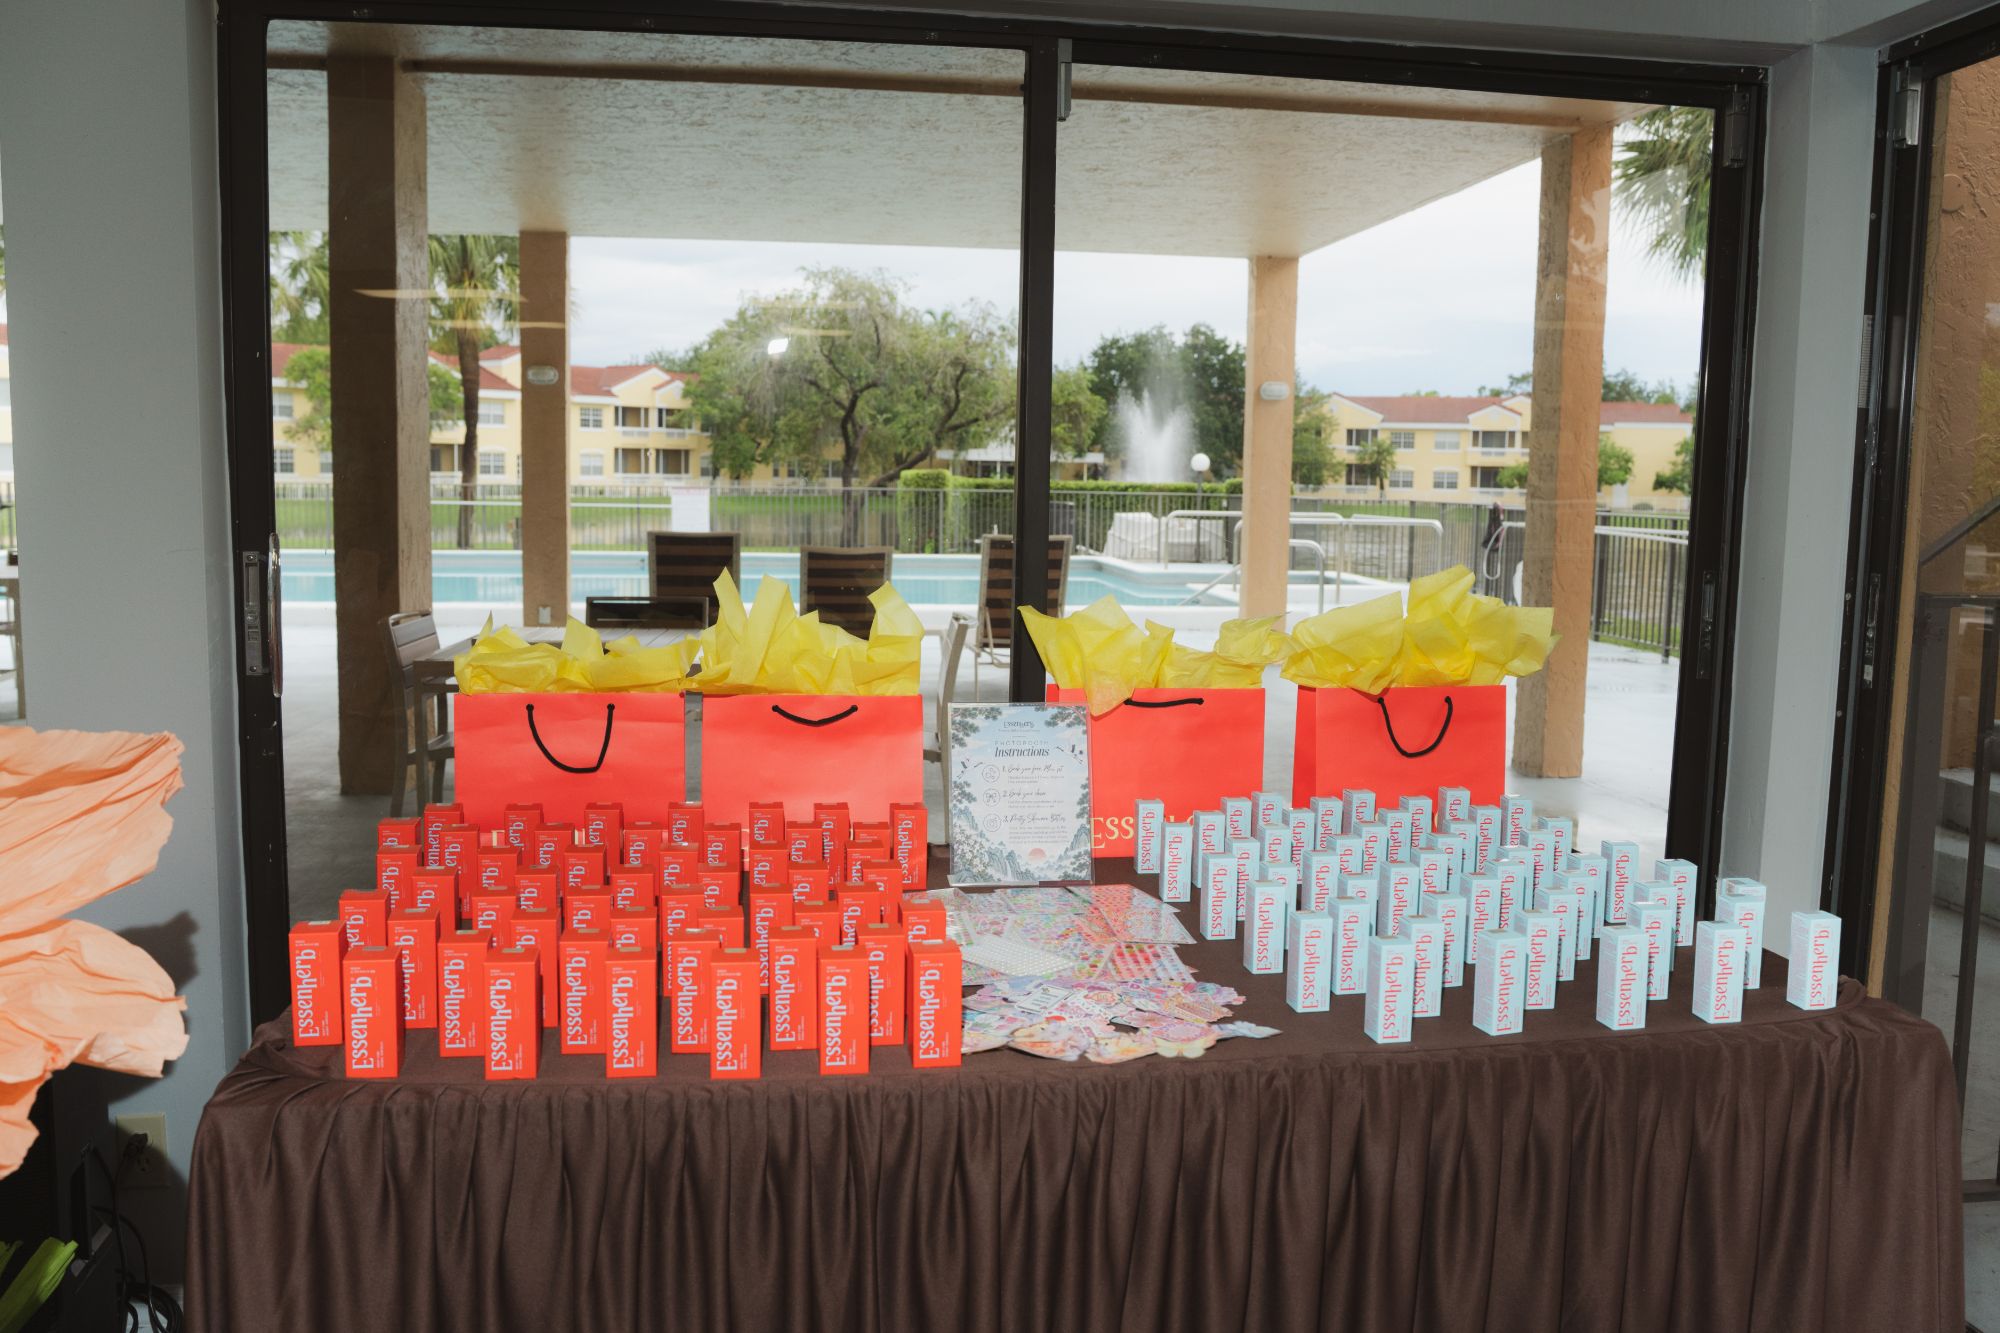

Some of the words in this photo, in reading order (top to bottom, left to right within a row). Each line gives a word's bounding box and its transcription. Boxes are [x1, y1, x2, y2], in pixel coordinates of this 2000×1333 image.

[994, 746, 1050, 758] Instructions
[1141, 811, 1156, 871] Essenherb
[1167, 835, 1182, 900] Essenherb
[1510, 807, 1524, 846] enherb
[1211, 868, 1228, 937] Essenherb
[1315, 865, 1330, 911] enherb
[1613, 854, 1630, 920] Essenherb
[1257, 897, 1275, 971] Essenherb
[1302, 930, 1321, 1009] Essenherb
[1340, 915, 1359, 991] Essenherb
[1413, 935, 1433, 1014] Essenherb
[1528, 928, 1548, 1007] Essenherb
[1810, 929, 1830, 1008] Essenherb
[296, 949, 320, 1039] Essenherb
[444, 959, 466, 1049] Essenherb
[566, 956, 588, 1046] Essenherb
[678, 956, 698, 1045] Essenherb
[774, 954, 795, 1042] Essenherb
[826, 975, 847, 1067] Essenherb
[919, 968, 941, 1060] Essenherb
[1382, 956, 1403, 1040] Essenherb
[1496, 950, 1516, 1032] Essenherb
[1618, 945, 1639, 1027] Essenherb
[1714, 939, 1735, 1021] Essenherb
[350, 976, 374, 1070] Essenherb
[490, 978, 513, 1071] Essenherb
[612, 976, 634, 1069] Essenherb
[716, 978, 738, 1071] Essenherb
